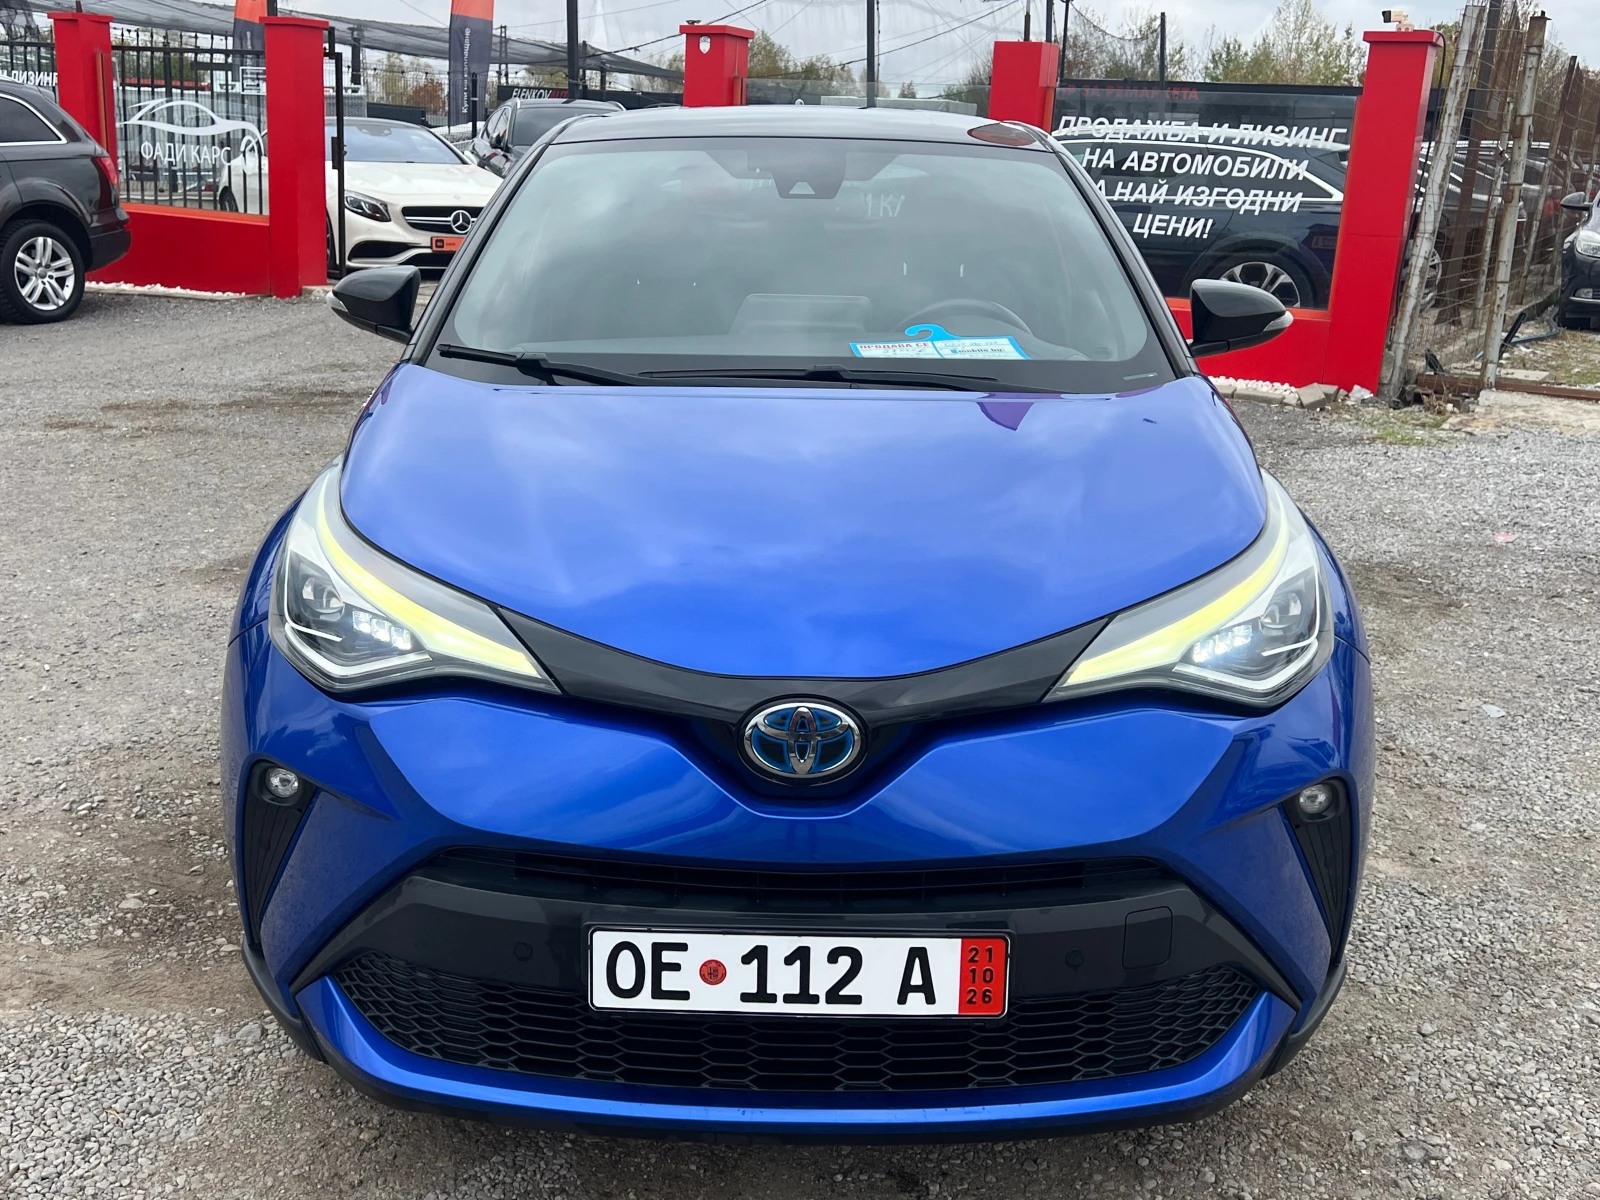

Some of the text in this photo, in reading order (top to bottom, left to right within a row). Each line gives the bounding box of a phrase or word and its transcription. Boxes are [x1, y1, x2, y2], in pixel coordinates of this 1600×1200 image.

[1058, 116, 1348, 149] ПРОДАЖБА И ЛИЗИНГ
[141, 141, 232, 166] ФАДИ КАРС
[1081, 147, 1309, 181] НА АВТОМОБИЛИ
[1114, 178, 1167, 205] НАЙ
[1173, 185, 1303, 216] ИЗГОДНИ
[1133, 213, 1214, 239] ЦЕНИ!
[967, 946, 994, 964] 21
[606, 940, 691, 1001] OE
[740, 944, 863, 1005] 112
[896, 946, 937, 1006] A
[968, 967, 994, 985] 10
[966, 988, 993, 1005] 26
